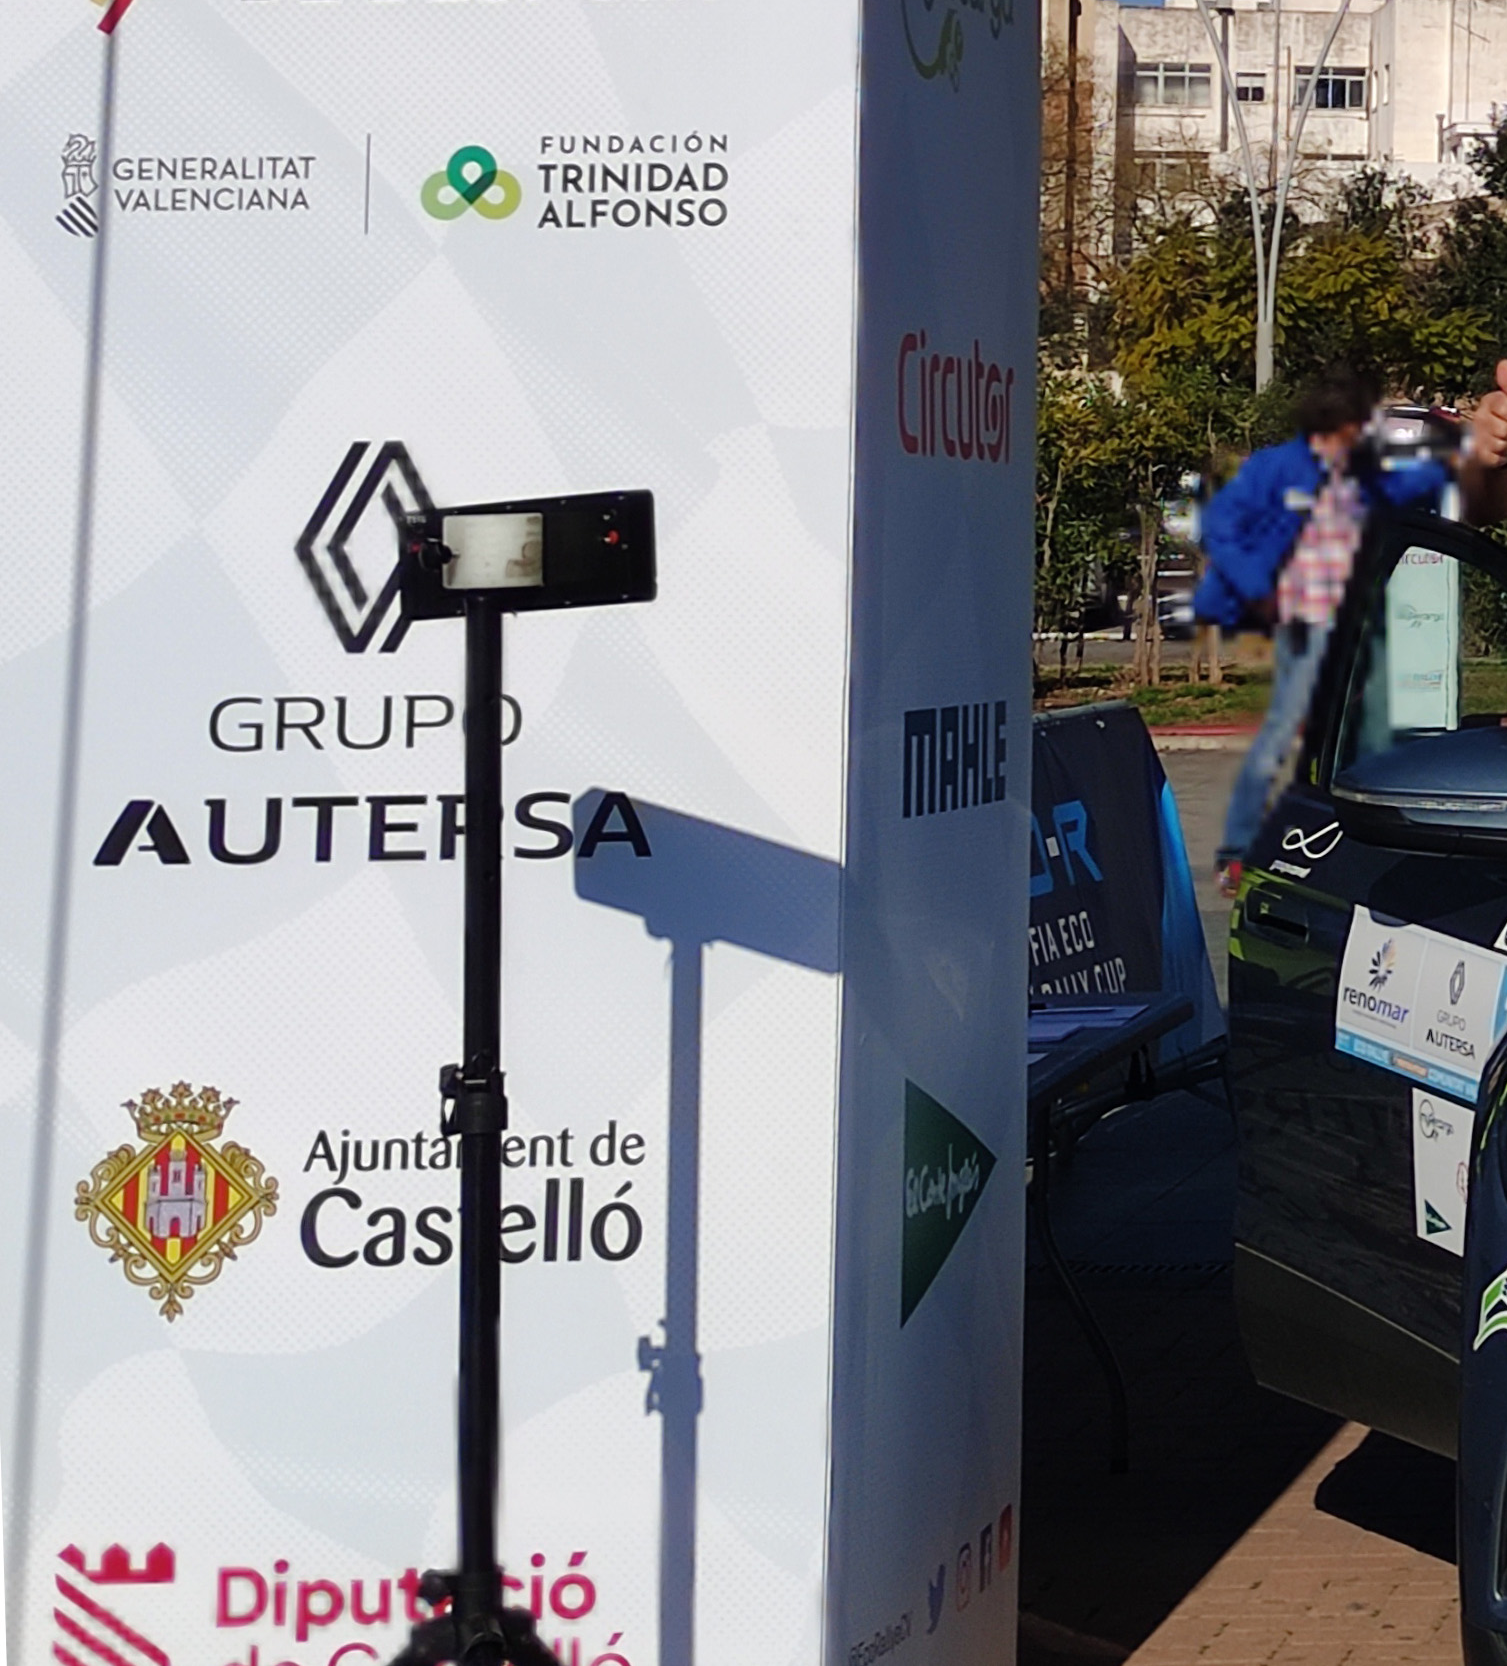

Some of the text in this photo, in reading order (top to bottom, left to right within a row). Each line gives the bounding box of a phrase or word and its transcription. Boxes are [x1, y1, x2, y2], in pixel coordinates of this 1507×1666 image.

[540, 131, 728, 155] FUNDACIÓN
[111, 155, 316, 182] GENERALITAT
[537, 163, 729, 194] TRINIDAD
[114, 187, 311, 212] VALENCIANA
[537, 198, 728, 229] ALFONSO
[899, 330, 1014, 465] Circutor
[903, 701, 1006, 819] MAHLE
[1028, 911, 1094, 966] FIA ECO
[1343, 986, 1410, 1024] renomar
[1437, 1009, 1466, 1032] GRUPO
[1425, 1028, 1477, 1060] AUTERSA
[303, 1120, 646, 1185] Ajuntaent de
[300, 1177, 644, 1268] Caselló
[216, 1551, 597, 1643] Diputió
